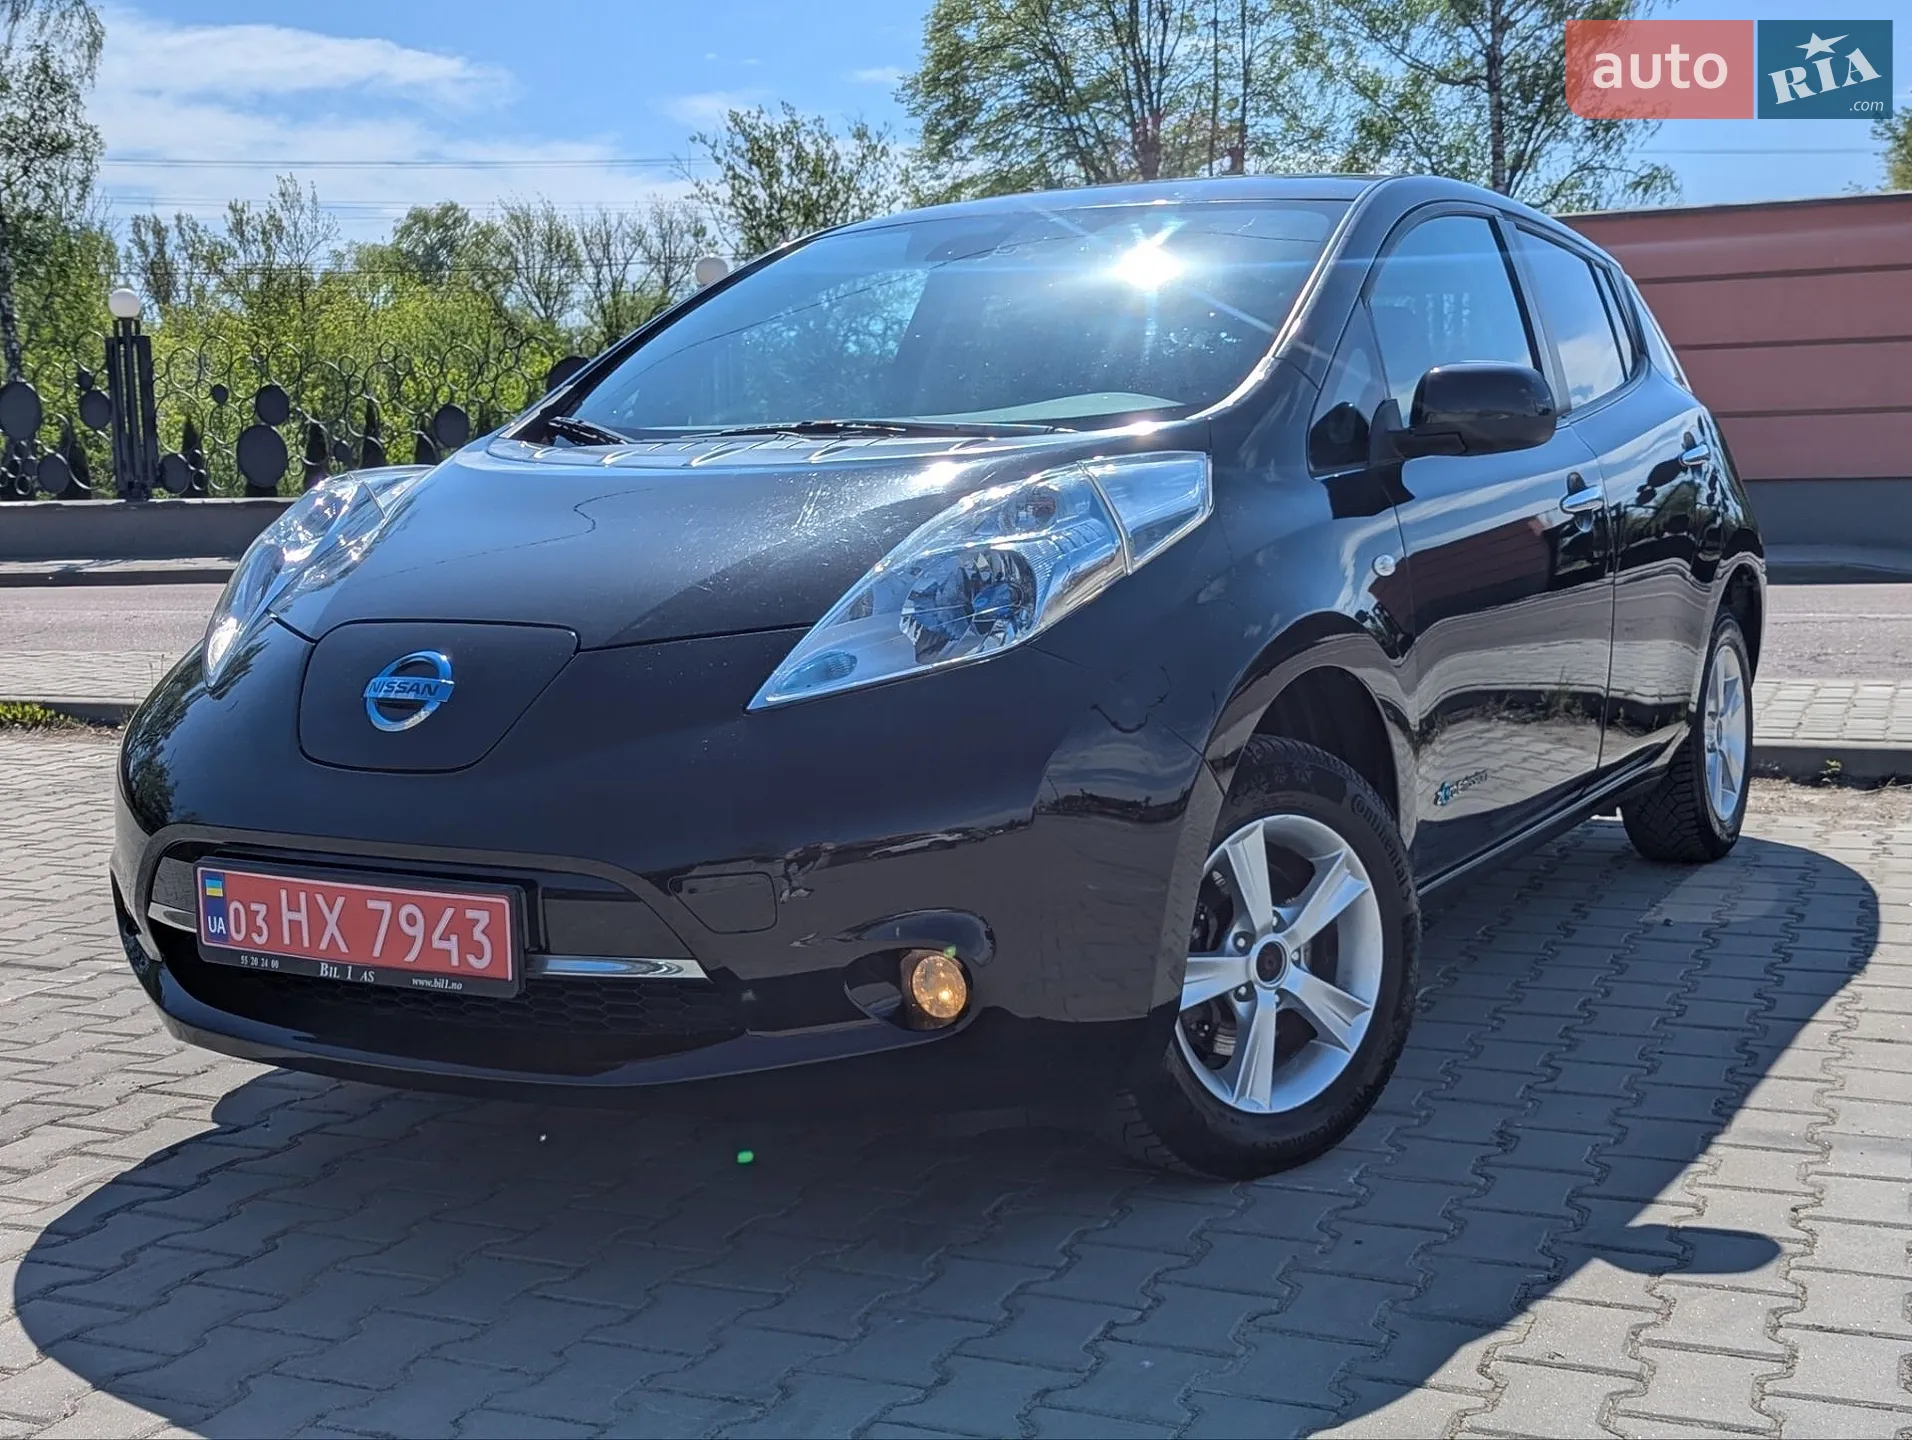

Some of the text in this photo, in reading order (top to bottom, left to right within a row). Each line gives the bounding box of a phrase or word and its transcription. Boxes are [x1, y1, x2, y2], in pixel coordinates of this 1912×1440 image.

[368, 681, 440, 697] NISSAN
[208, 916, 227, 935] UA
[228, 888, 494, 970] 03 HX 7943
[240, 955, 249, 965] 55
[251, 956, 260, 967] 20
